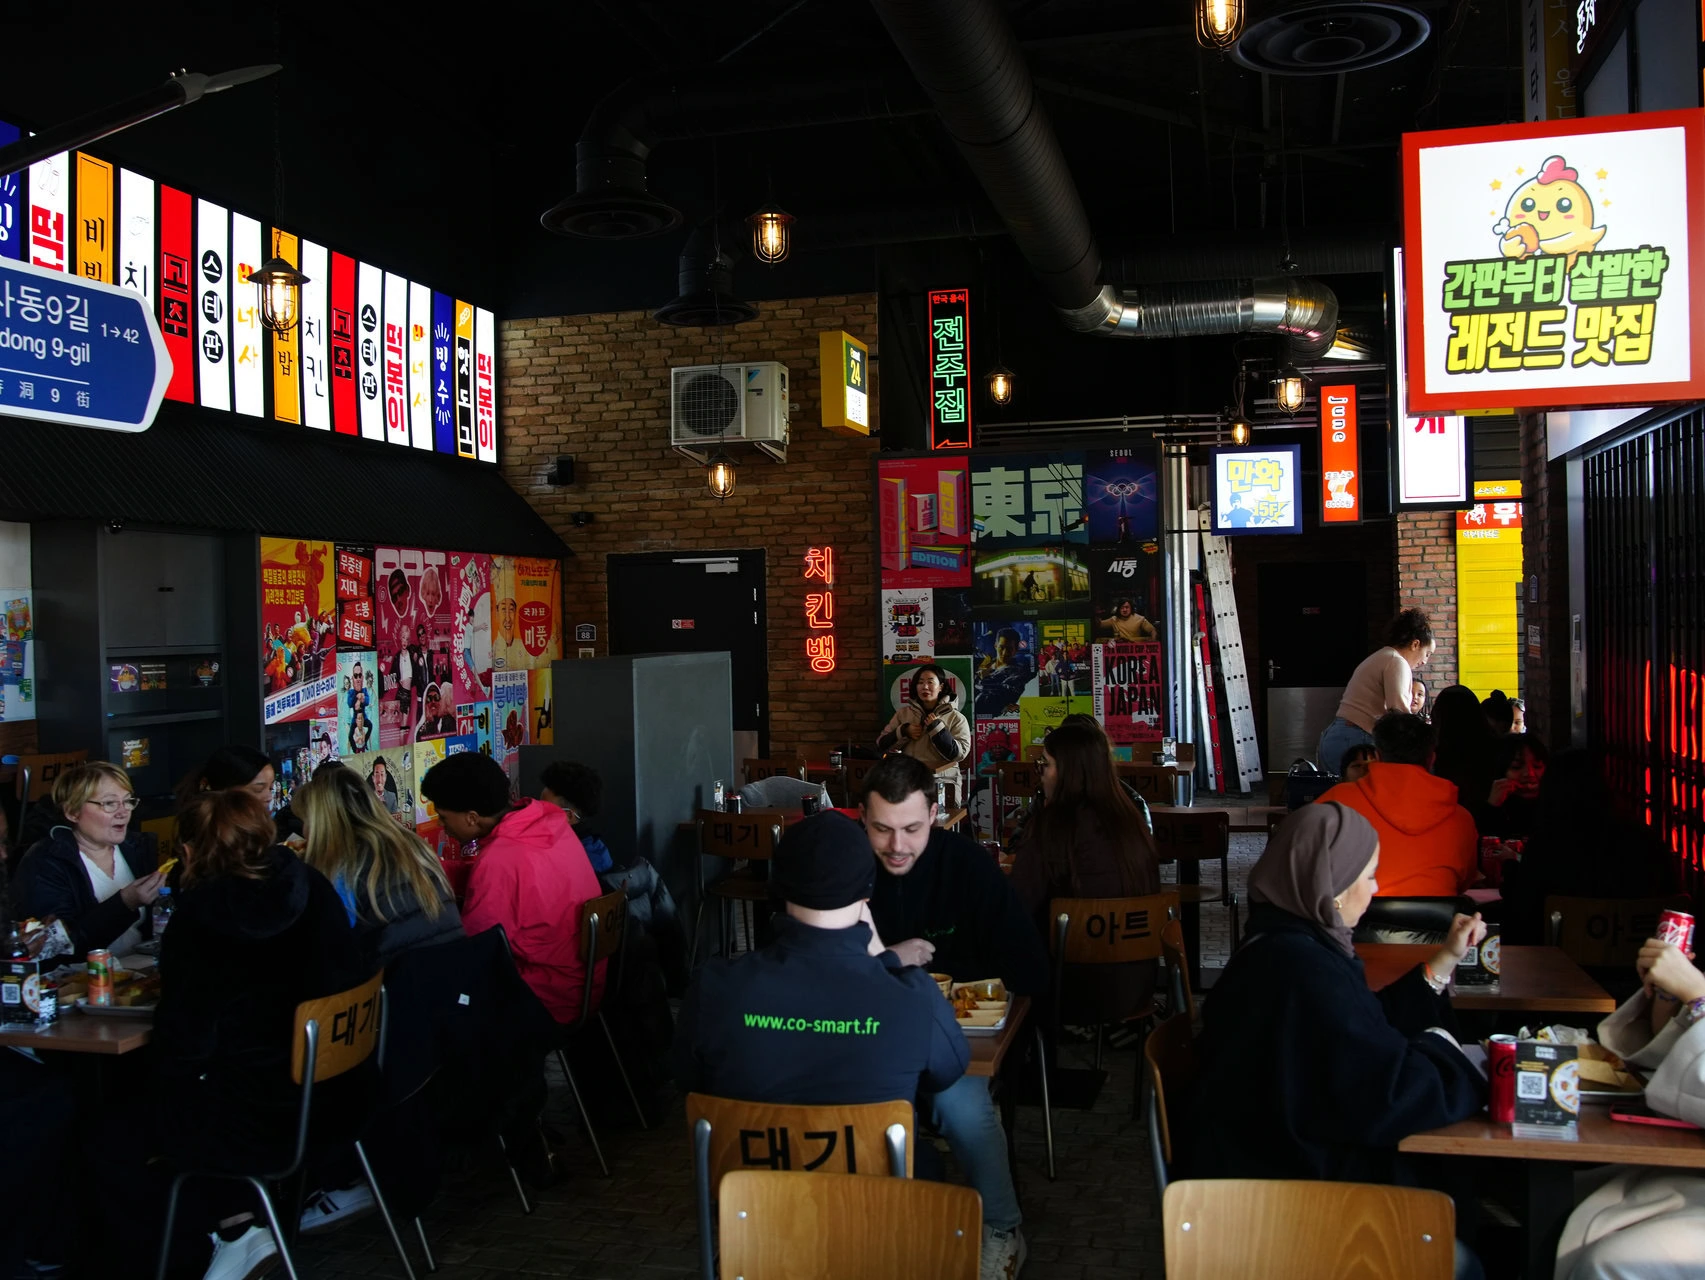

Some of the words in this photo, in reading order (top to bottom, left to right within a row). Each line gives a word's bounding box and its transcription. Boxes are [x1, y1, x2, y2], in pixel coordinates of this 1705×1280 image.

[163, 252, 188, 338] 고추
[1444, 252, 1567, 310] 간판부터
[1570, 246, 1668, 302] 살발한
[202, 250, 224, 364] 스테판
[52, 337, 91, 366] 9-gil
[305, 316, 324, 397] 치킨
[333, 307, 352, 380] 고추
[361, 304, 378, 400] 스테판
[1447, 307, 1567, 374] 레전드
[1572, 303, 1655, 368] 맛집
[435, 346, 450, 405] 빙수
[850, 359, 861, 386] 24
[933, 316, 966, 424] 전주집
[457, 346, 473, 445] 핫도그
[1328, 396, 1349, 443] june
[1109, 449, 1133, 457] SEOUL
[1227, 458, 1283, 493] 만화
[911, 551, 958, 569] EDITION
[1107, 559, 1138, 579] 시동
[340, 579, 358, 596] 지대
[804, 546, 835, 673] 치킨뱅
[524, 625, 548, 649] 미풍
[581, 632, 591, 640] 88
[1105, 656, 1159, 684] KOREA
[1109, 687, 1161, 715] JAPAN
[713, 822, 758, 848] 대기
[1087, 911, 1150, 945] 아트
[331, 999, 378, 1047] 대기
[743, 1013, 881, 1034] www.co-smart.fr
[740, 1125, 857, 1174] 대기
